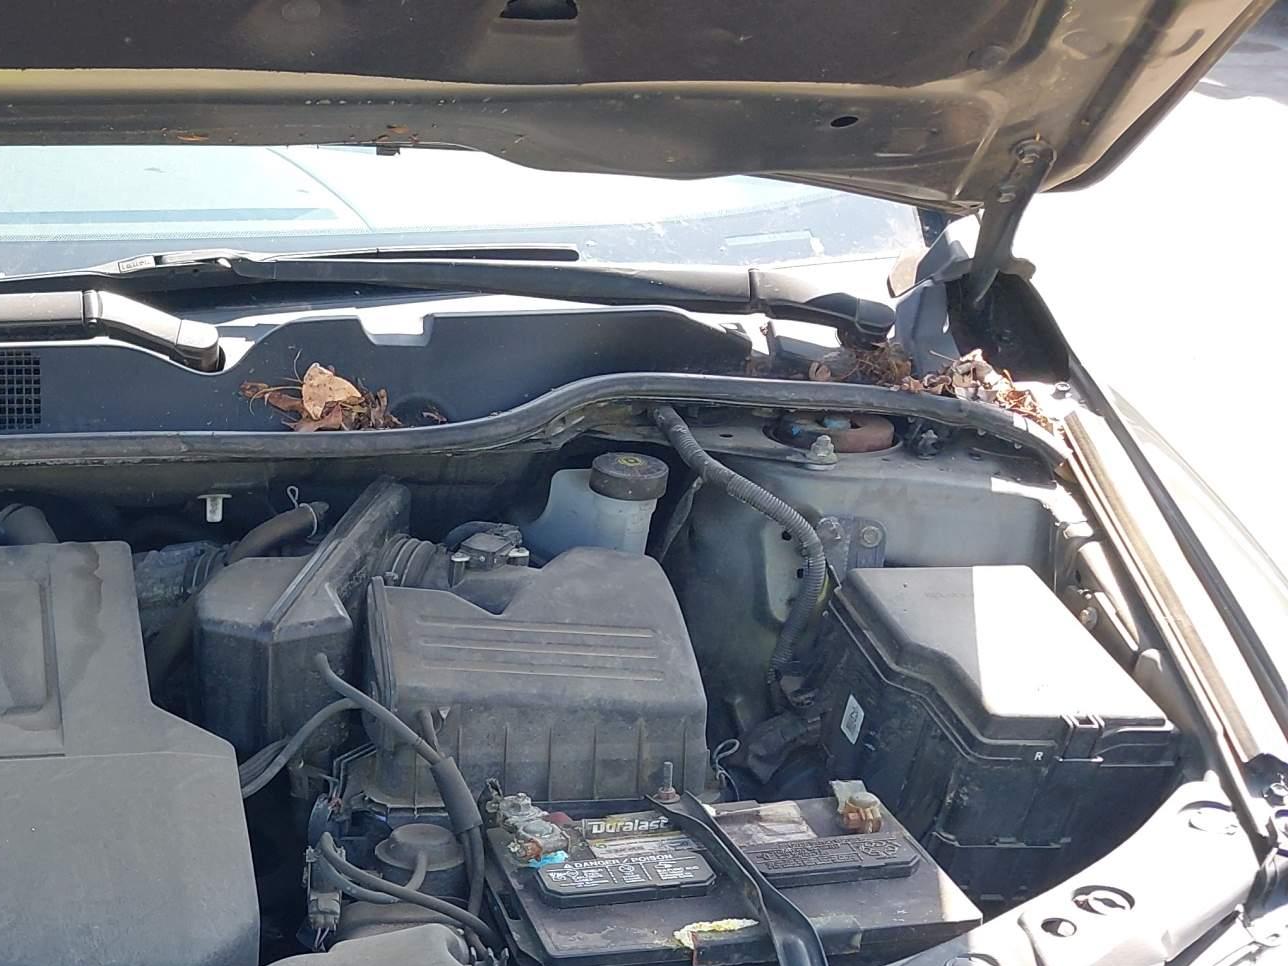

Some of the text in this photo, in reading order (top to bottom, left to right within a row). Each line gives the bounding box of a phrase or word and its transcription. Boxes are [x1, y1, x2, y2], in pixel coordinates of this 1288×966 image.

[587, 815, 669, 834] Duralast
[573, 859, 620, 868] DANGER
[631, 854, 673, 863] POISON
